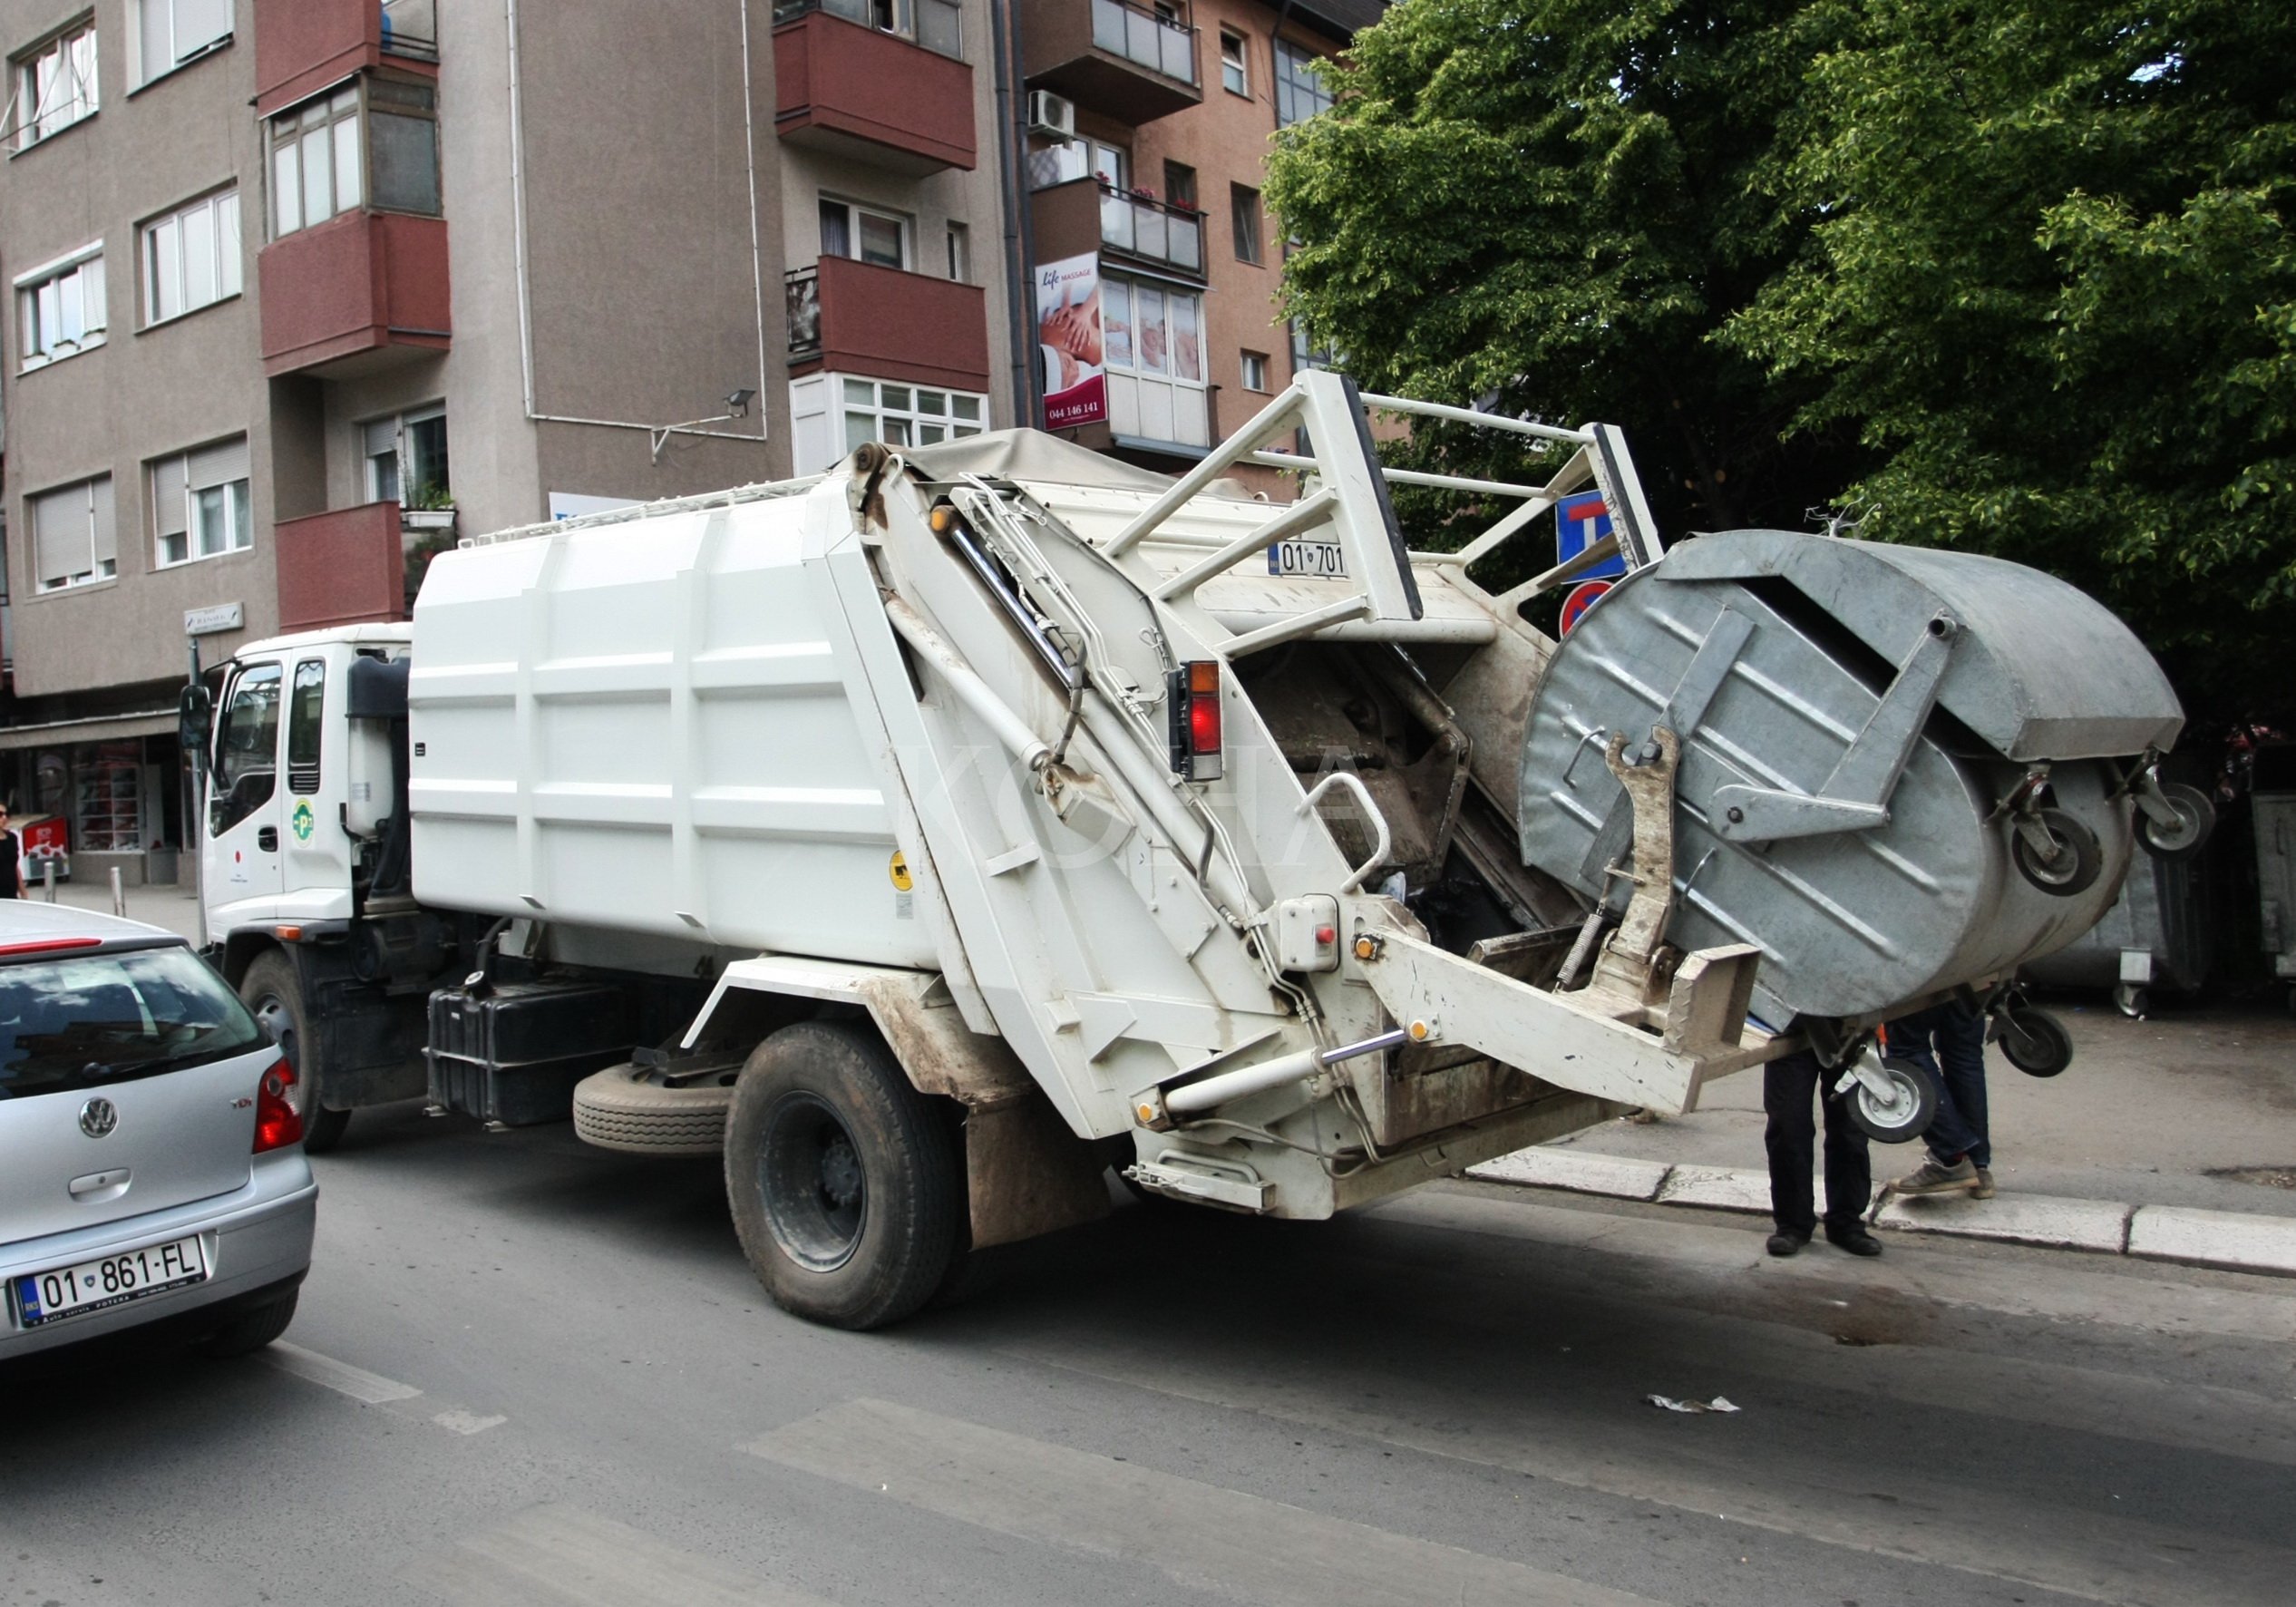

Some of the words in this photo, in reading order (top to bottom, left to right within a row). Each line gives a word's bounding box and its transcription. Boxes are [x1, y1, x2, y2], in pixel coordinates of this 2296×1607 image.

[1043, 270, 1060, 290] life
[1061, 268, 1091, 281] MASSAGE
[1049, 408, 1065, 420] 044
[1067, 404, 1082, 416] 146
[1084, 402, 1098, 414] 141
[1282, 543, 1304, 571] 01
[1316, 545, 1344, 573] 701
[44, 1271, 79, 1308] 01
[101, 1242, 196, 1293] 861-FL
